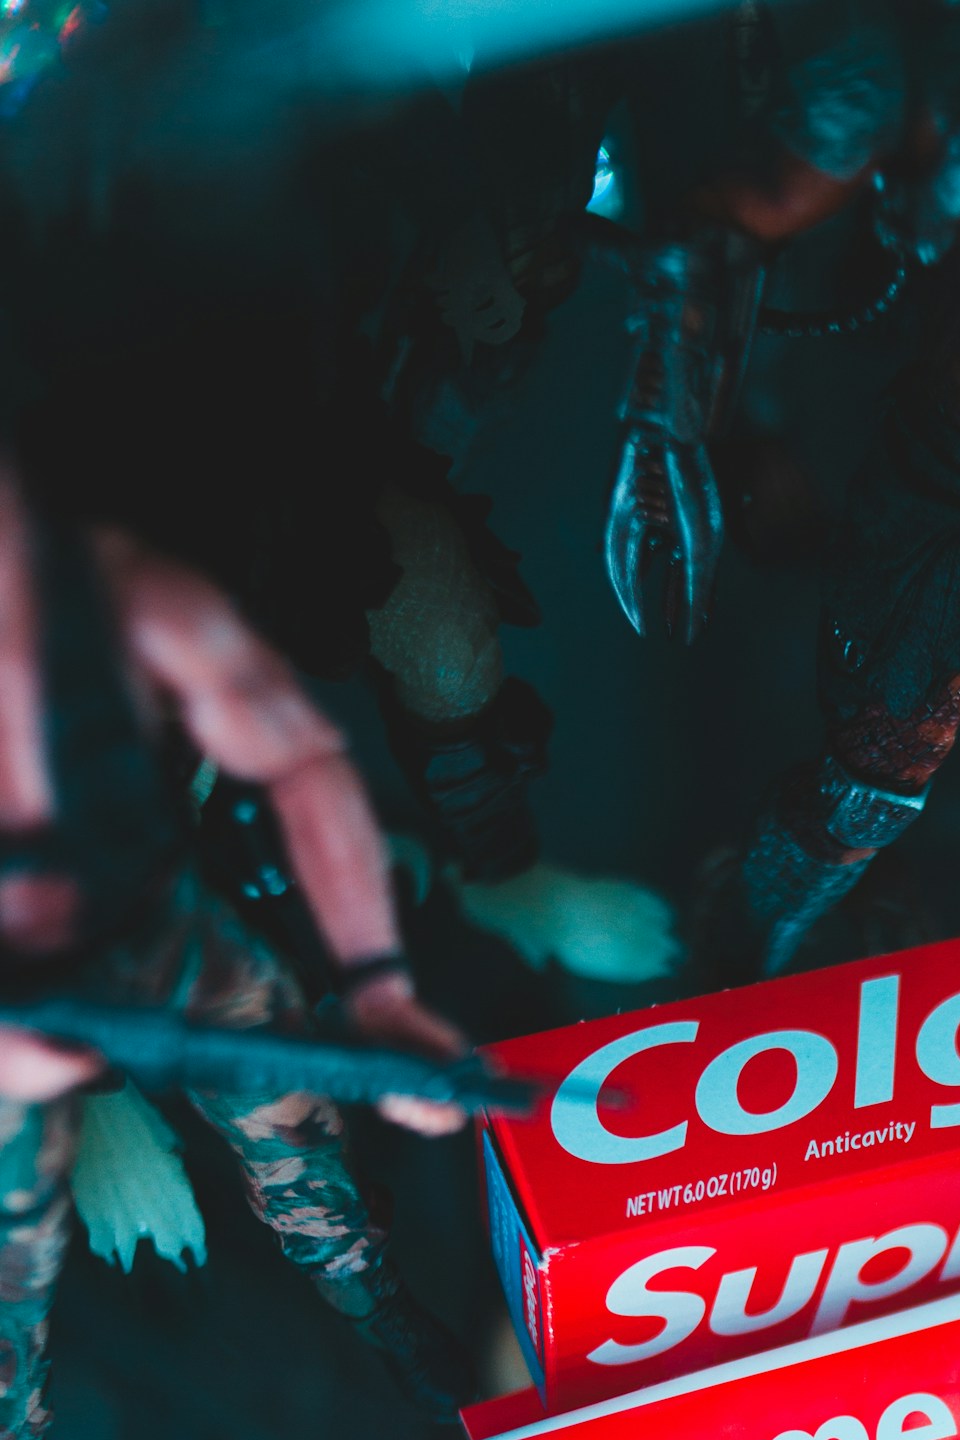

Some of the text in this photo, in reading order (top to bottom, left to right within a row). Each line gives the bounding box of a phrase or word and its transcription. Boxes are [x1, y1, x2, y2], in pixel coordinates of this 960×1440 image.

[803, 1120, 916, 1161] Anticavity
[626, 1191, 656, 1218] NET
[657, 1185, 682, 1210] WT
[682, 1181, 705, 1204] 6.0
[706, 1173, 728, 1197] OZ
